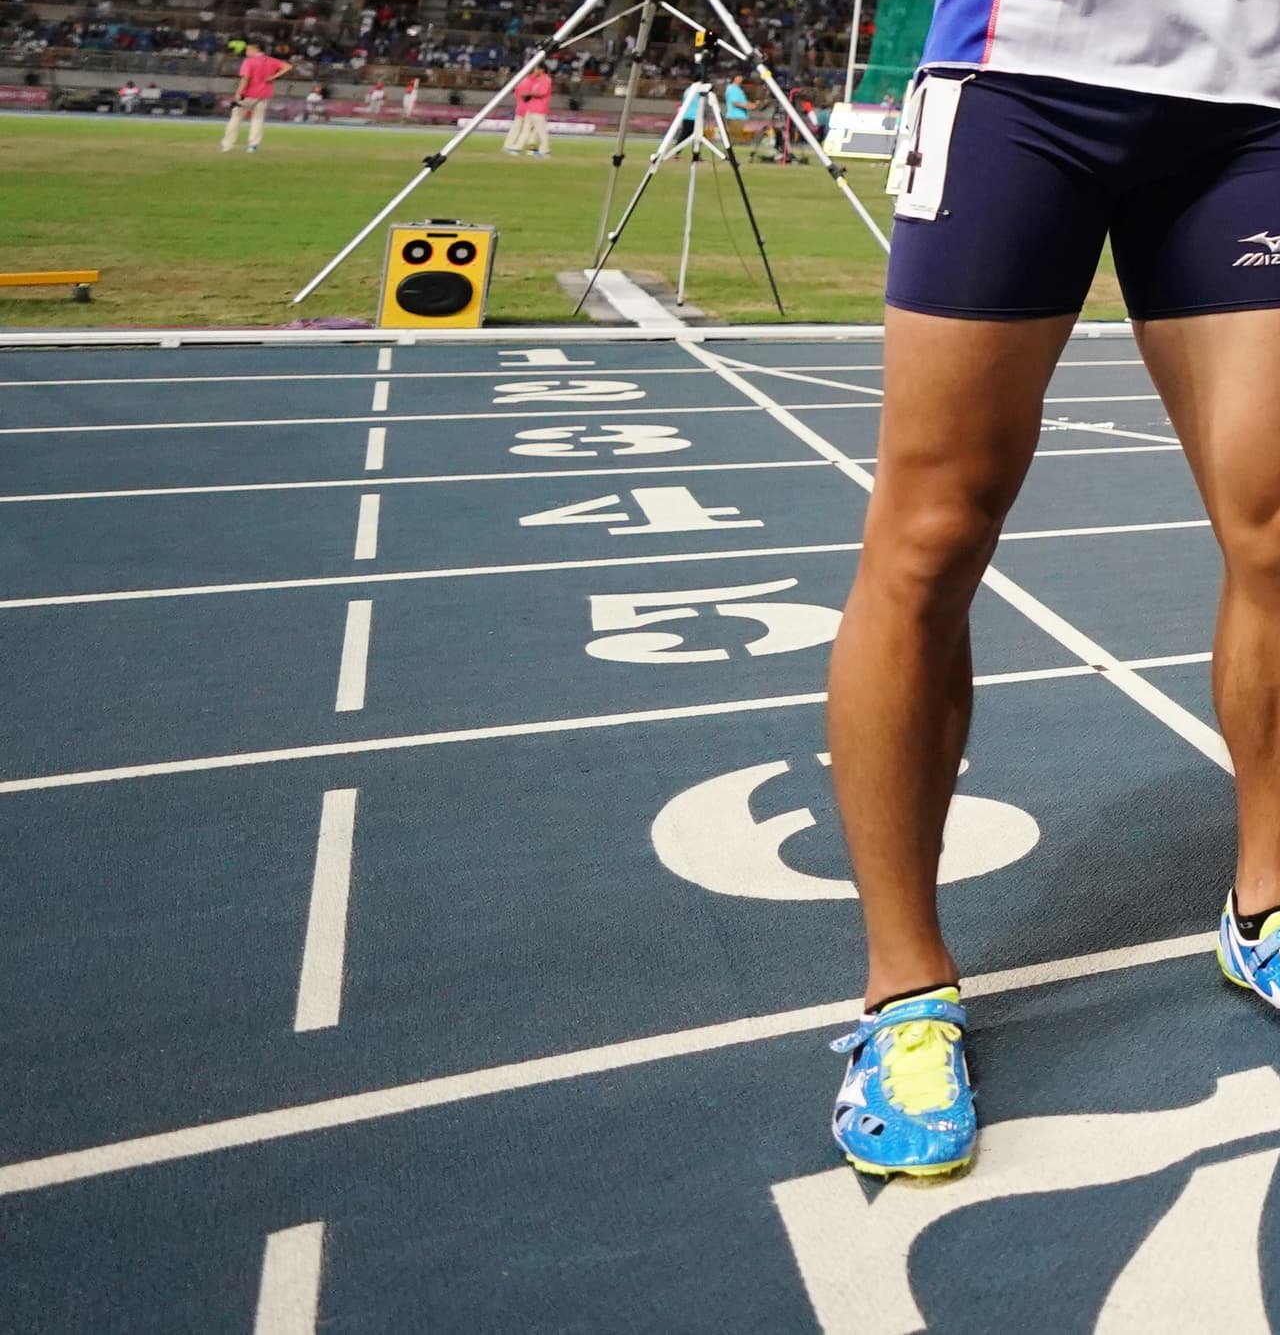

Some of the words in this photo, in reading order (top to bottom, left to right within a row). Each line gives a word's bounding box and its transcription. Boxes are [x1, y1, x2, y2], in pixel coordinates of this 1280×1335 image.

[498, 348, 595, 366] 1
[492, 380, 647, 404] 2
[508, 424, 692, 457] 3
[519, 486, 764, 535] 4
[585, 577, 844, 664] 5
